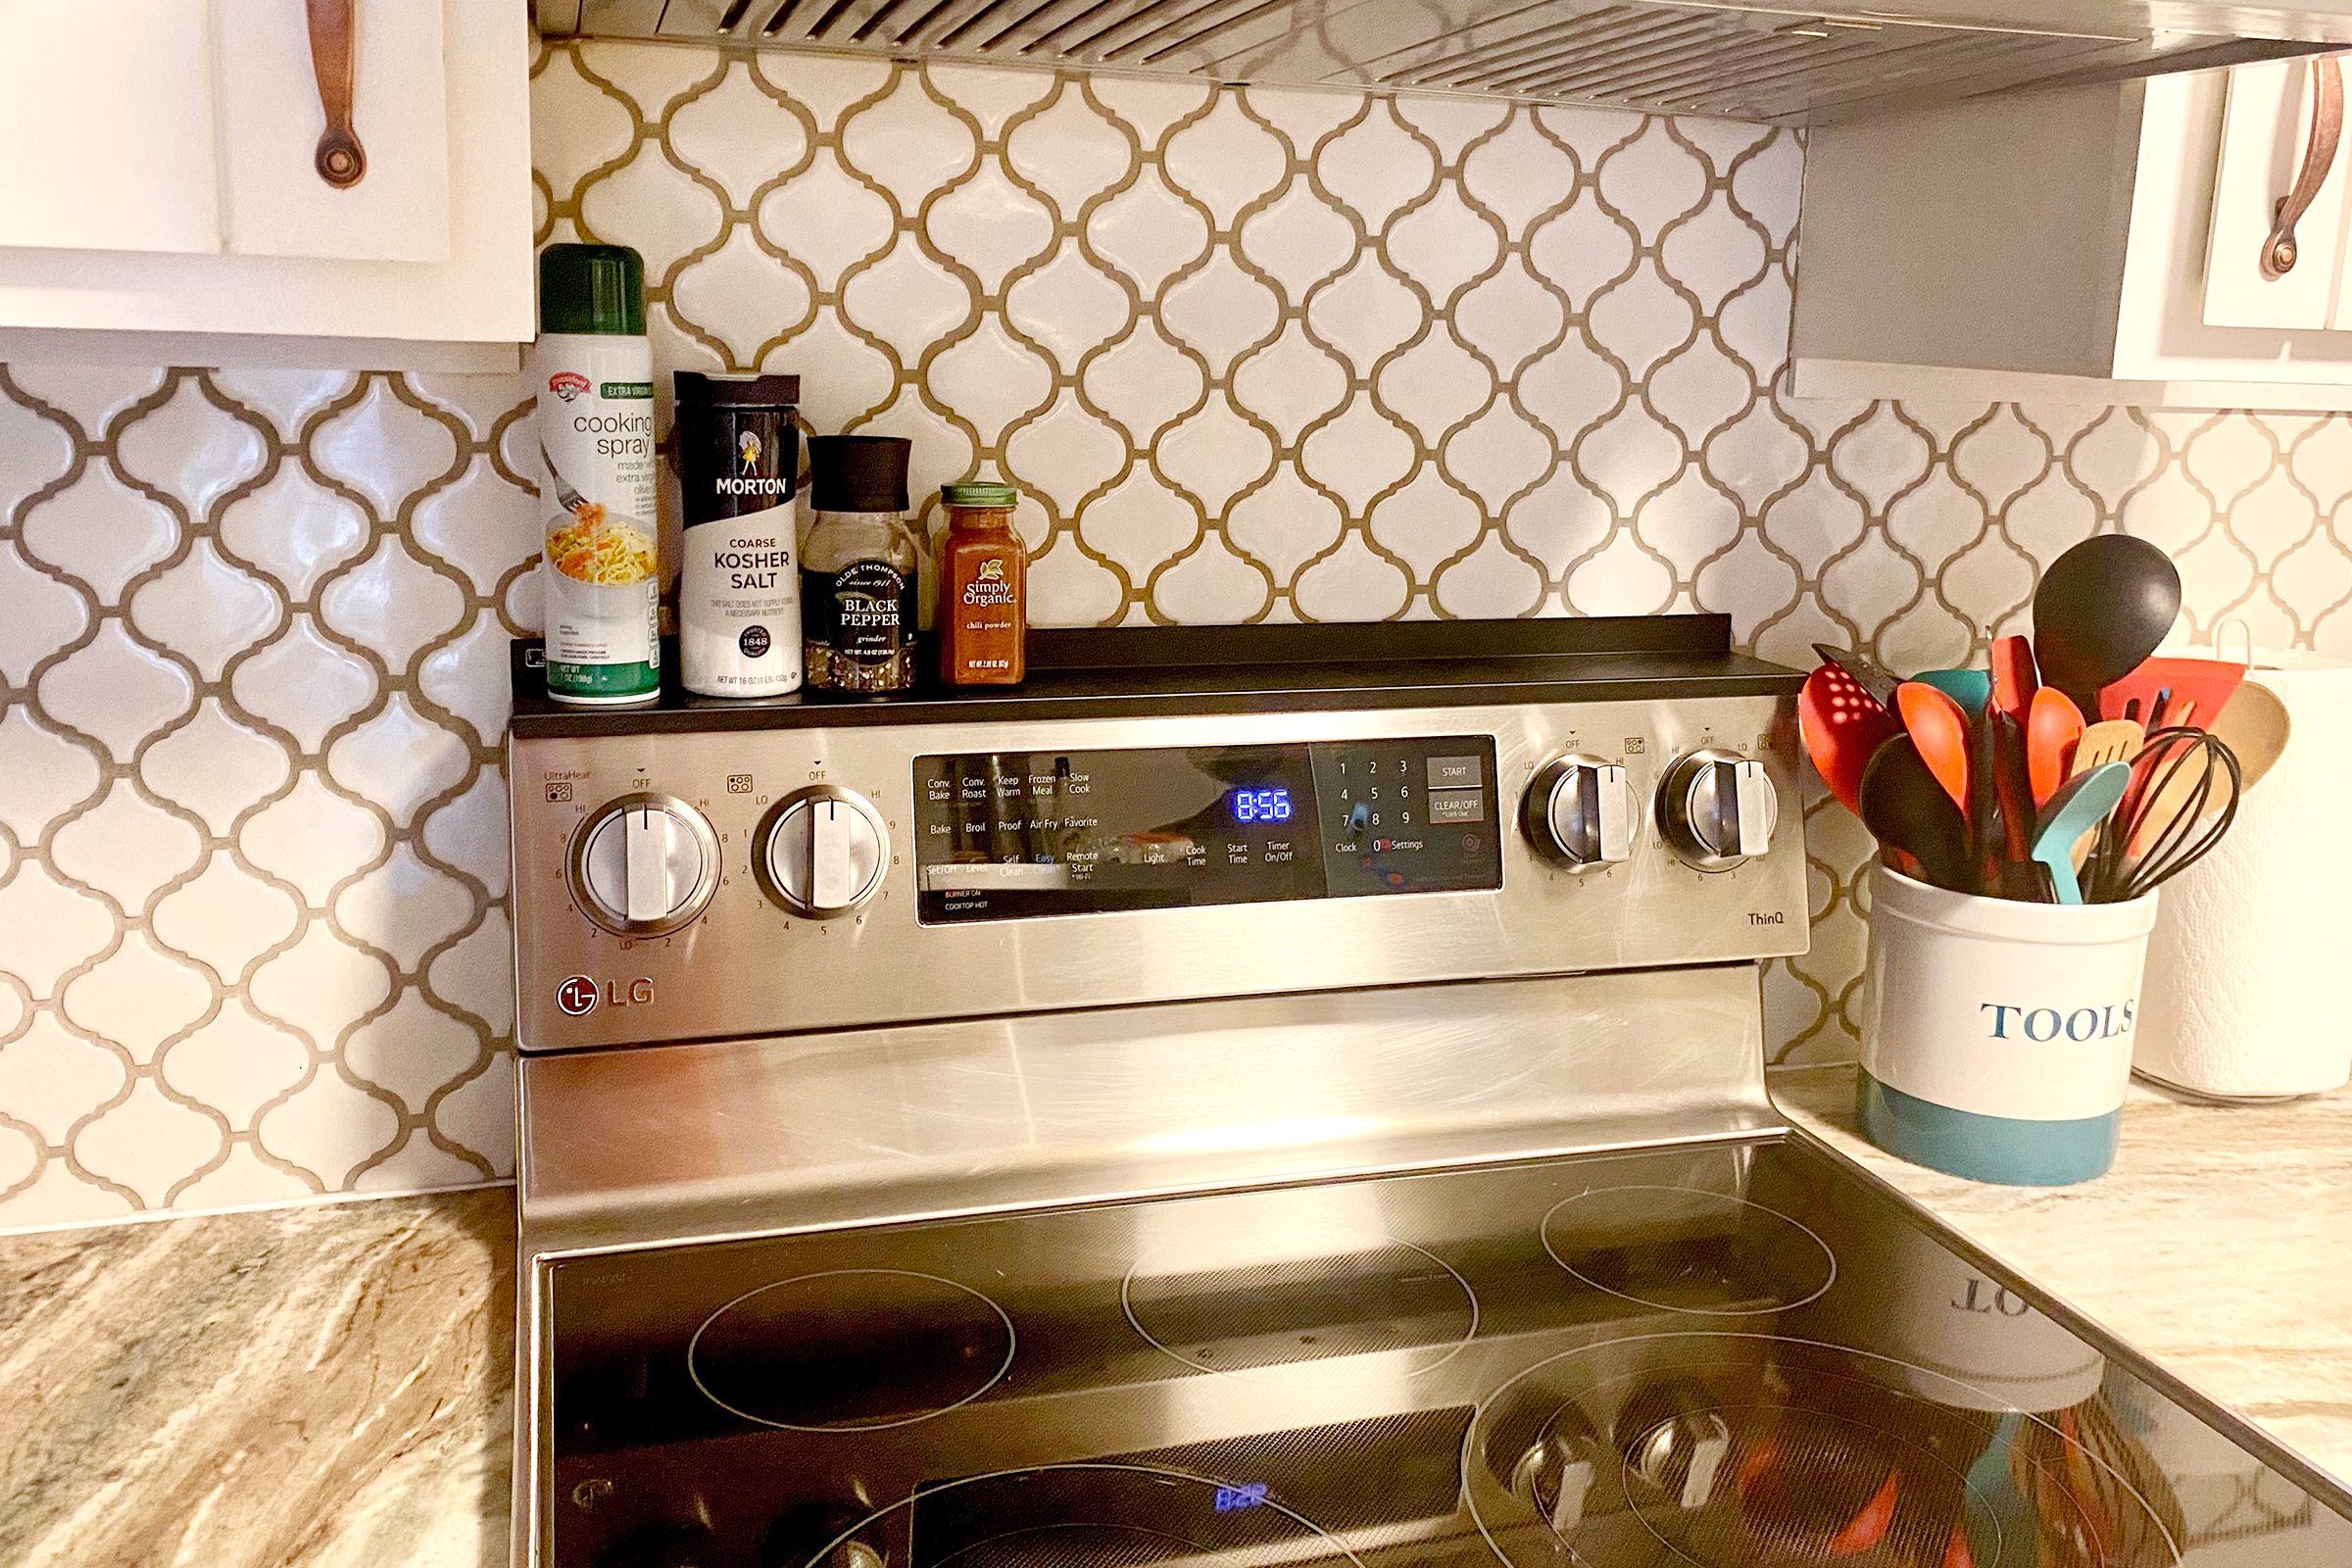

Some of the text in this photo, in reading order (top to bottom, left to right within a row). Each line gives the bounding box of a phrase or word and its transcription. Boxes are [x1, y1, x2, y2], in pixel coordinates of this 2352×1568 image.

[574, 413, 652, 437] cooking
[597, 438, 650, 459] spray
[617, 461, 644, 470] made
[615, 474, 640, 483] extra
[716, 478, 787, 495] MORTON
[729, 538, 776, 548] COARSE
[714, 551, 790, 569] KOSHER
[731, 572, 778, 589] SALT
[836, 564, 906, 590] OLDE THOMPSON
[967, 580, 1011, 595] Simply
[963, 592, 1015, 608] Organic
[845, 600, 898, 612] BLACK
[840, 613, 901, 626] PEPPER
[984, 621, 1011, 630] powder
[744, 637, 767, 647] 1848
[858, 635, 887, 644] grinder
[717, 675, 728, 684] NET
[748, 676, 758, 685] OZ
[1565, 740, 1580, 749] OFF
[1701, 737, 1714, 746] OFF
[1672, 746, 1680, 755] HI
[1340, 763, 1346, 774] 1
[1370, 761, 1377, 773] 2
[1399, 760, 1407, 772] 3
[1524, 761, 1535, 770] LO
[544, 771, 591, 782] UltraHeat
[808, 771, 827, 781] OFF
[1442, 766, 1466, 777] START
[962, 777, 985, 787] Conv.
[998, 776, 1019, 787] Keep
[1028, 774, 1056, 784] Frozen
[1069, 773, 1090, 782] Slow
[632, 778, 651, 789] OFF
[927, 779, 951, 789] Conv.
[962, 789, 987, 799] Roast
[997, 788, 1021, 797] Warm
[1032, 786, 1054, 795] Meal
[1069, 784, 1090, 794] Cook
[1371, 788, 1378, 799] 5
[1400, 786, 1408, 799] 6
[871, 790, 881, 799] HI
[929, 791, 951, 800] Bake
[1341, 789, 1348, 800] 4
[700, 799, 710, 808] HI
[756, 795, 768, 805] LO
[1237, 789, 1290, 819] 8:56
[1434, 800, 1479, 811] CLEAR/OFF
[1064, 817, 1098, 828] Favorite
[1342, 814, 1349, 826] 7
[1371, 813, 1380, 825] 8
[1402, 812, 1409, 824] 9
[890, 820, 896, 830] 9
[930, 824, 952, 834] Bake
[965, 822, 986, 832] Broil
[998, 820, 1021, 831] Proof
[1030, 818, 1058, 831] Air Fry
[721, 833, 728, 843] 8
[1186, 845, 1206, 855] Cook
[1227, 843, 1249, 853] Start
[1267, 841, 1290, 851] Timer
[1335, 843, 1357, 853] Clock
[1373, 840, 1381, 852] 0
[1392, 840, 1424, 852] Settings
[1653, 841, 1663, 850] LO
[894, 857, 900, 865] 8
[1003, 855, 1020, 864] Self
[1035, 854, 1054, 864] Easy
[1066, 852, 1099, 862] Remote
[1144, 853, 1164, 865] Light
[1187, 857, 1206, 866] Time
[1229, 855, 1249, 864] Time
[1264, 852, 1293, 862] On/Off
[742, 865, 748, 875] 2
[926, 864, 957, 875] Set/Off
[966, 863, 988, 873] Level
[1000, 866, 1024, 877] Clean
[1072, 862, 1094, 873] Start
[556, 868, 563, 879] 6
[1697, 873, 1703, 882] 6
[1731, 871, 1737, 880] 3
[722, 876, 729, 886] 6
[1579, 878, 1585, 887] 5
[883, 892, 889, 901] 7
[945, 890, 969, 899] BURNER
[757, 900, 762, 909] 3
[945, 901, 974, 910] COOKTOP
[701, 915, 708, 925] 4
[856, 915, 862, 925] 6
[1748, 912, 1785, 926] ThinQ
[783, 921, 790, 931] 4
[820, 926, 827, 935] 5
[591, 929, 597, 939] 2
[619, 940, 633, 951] LO
[664, 938, 671, 948] 2
[608, 977, 655, 1007] LG
[1980, 999, 2133, 1043] TOOLS
